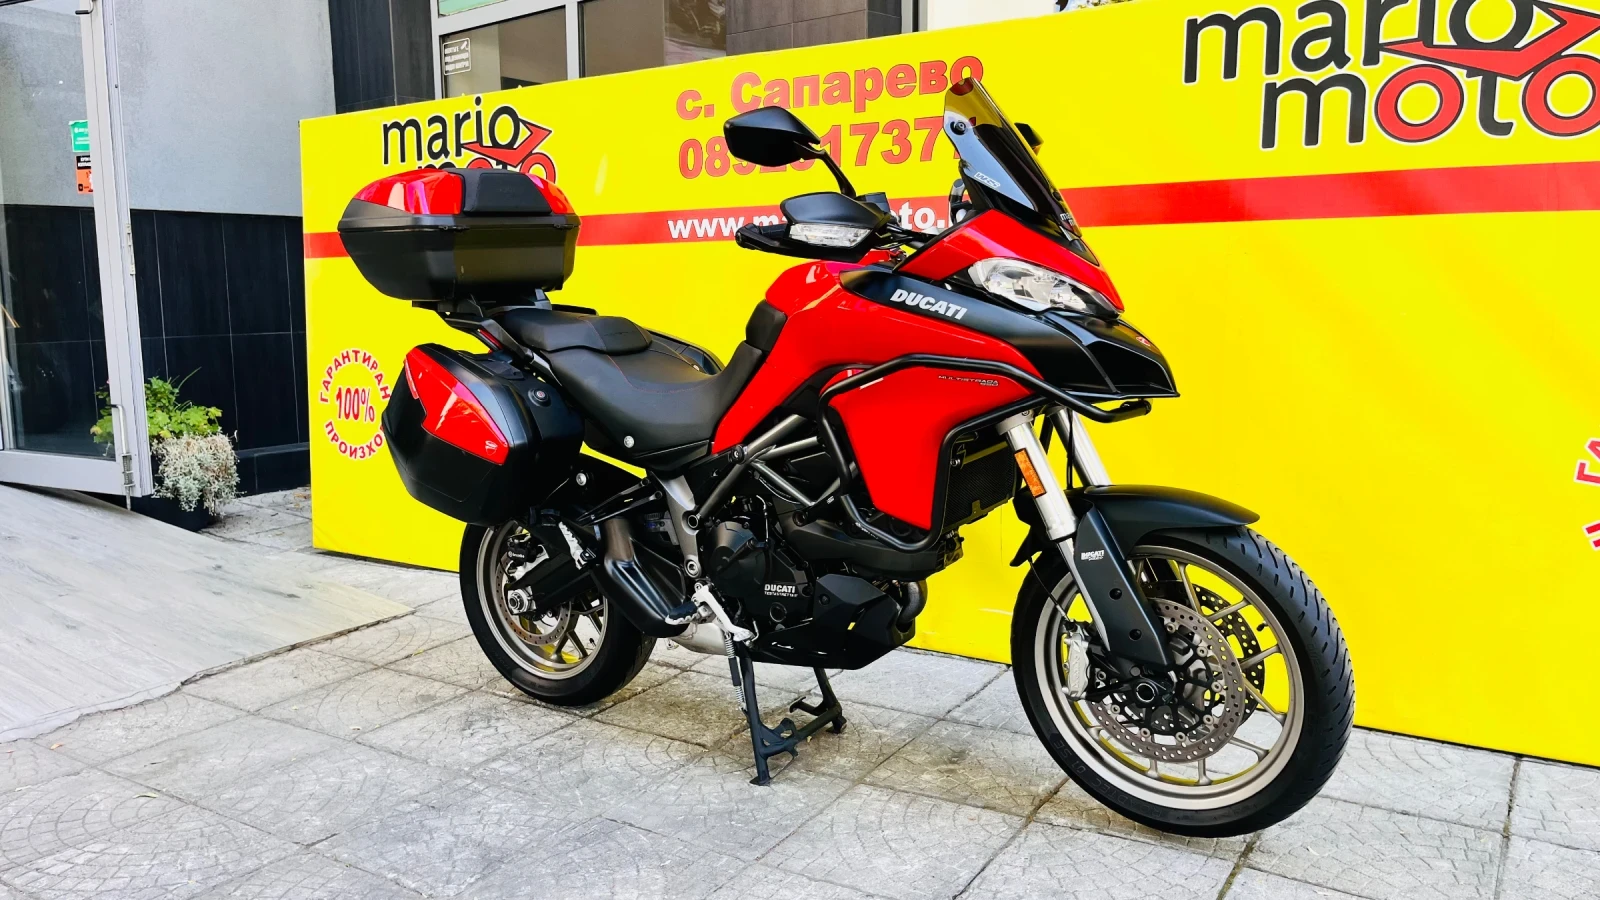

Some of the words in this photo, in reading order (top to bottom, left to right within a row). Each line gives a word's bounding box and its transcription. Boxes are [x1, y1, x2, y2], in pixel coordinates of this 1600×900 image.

[1184, 0, 1534, 83] mario
[731, 56, 984, 114] Сапарево
[1262, 54, 1600, 148] moto
[383, 96, 520, 164] mario
[679, 116, 977, 179] 081737
[890, 288, 968, 320] DUCATI
[320, 350, 391, 402] ГАРАНТИРАН
[336, 387, 375, 422] 100%
[325, 421, 384, 459] ПРОИЗХО
[764, 583, 796, 593] DUCATI
